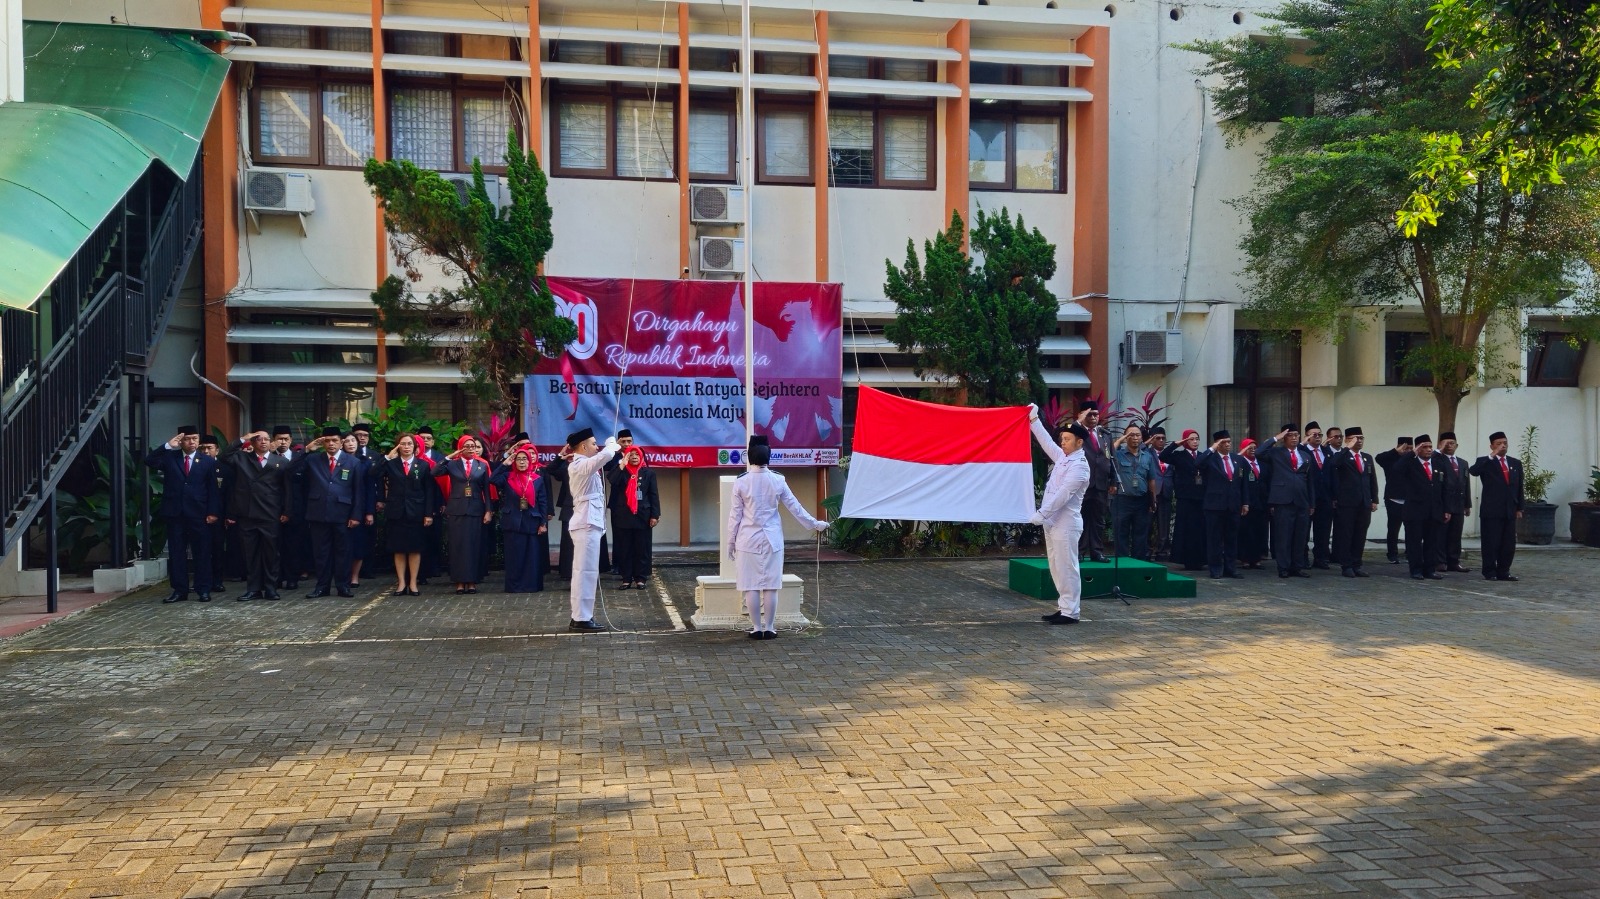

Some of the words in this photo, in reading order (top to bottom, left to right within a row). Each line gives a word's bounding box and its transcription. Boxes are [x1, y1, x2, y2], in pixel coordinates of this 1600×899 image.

[633, 310, 739, 342] Dirgahayu
[605, 344, 684, 374] Republik
[685, 345, 771, 369] Indoneia
[549, 379, 610, 395] Bersatu
[614, 380, 691, 396] Berdaulat
[694, 381, 746, 399] Ratyat
[629, 404, 703, 419] Indonesia
[707, 404, 745, 422] Maju
